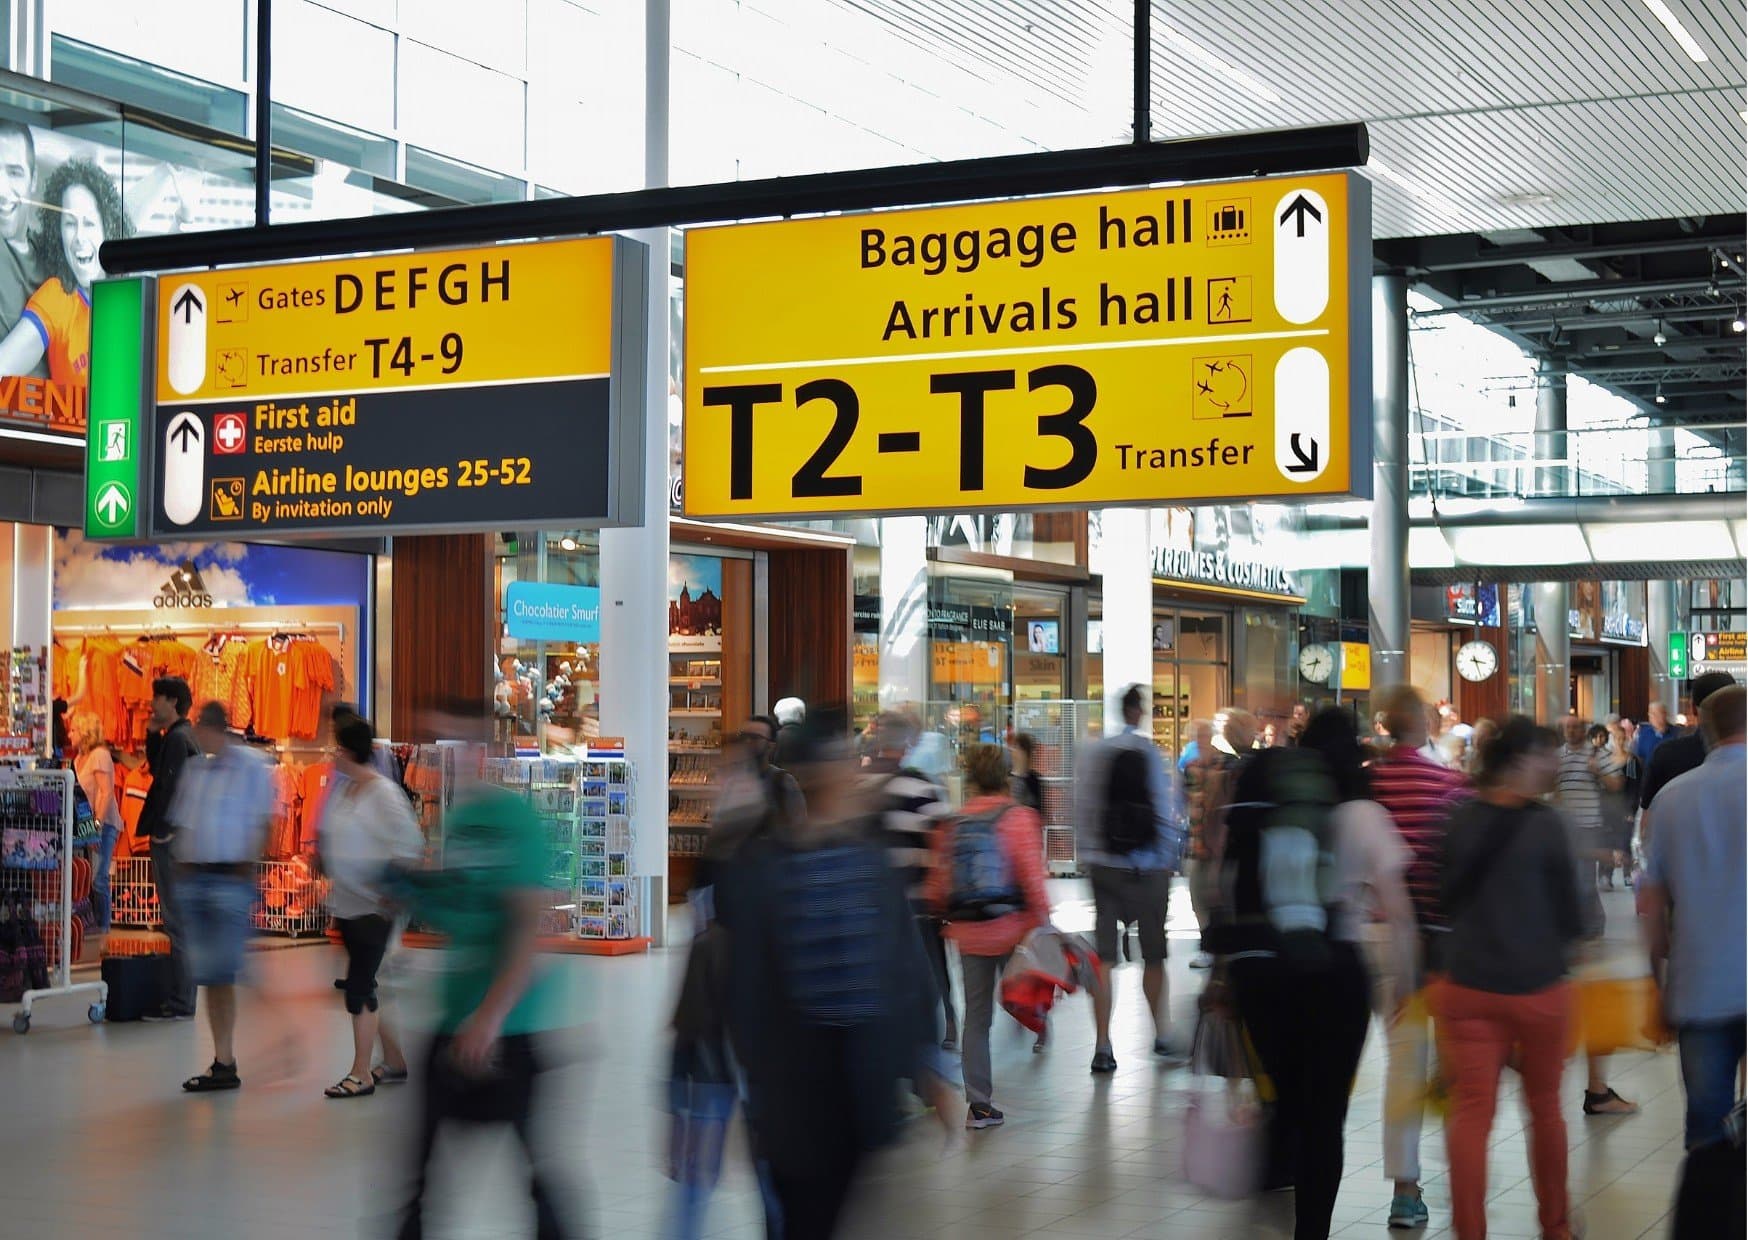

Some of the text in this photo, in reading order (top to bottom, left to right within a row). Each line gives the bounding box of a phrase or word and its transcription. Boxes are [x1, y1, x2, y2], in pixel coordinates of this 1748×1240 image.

[860, 198, 1192, 276] Baggage hall
[258, 287, 325, 310] Gates
[881, 276, 1192, 341] Arrivals hall
[257, 332, 464, 379] Transfer T4-9
[255, 398, 356, 430] First aid
[255, 432, 343, 454] Eerste hulp
[702, 363, 1098, 501] T2-T3
[1115, 437, 1255, 472] Transfer
[252, 457, 532, 496] Airline lounges 25-52
[252, 495, 393, 523] By invitation only
[1216, 551, 1226, 581] &
[1228, 560, 1289, 590] COSMETICS
[153, 591, 213, 608] adidas
[513, 599, 569, 619] Chocolatier
